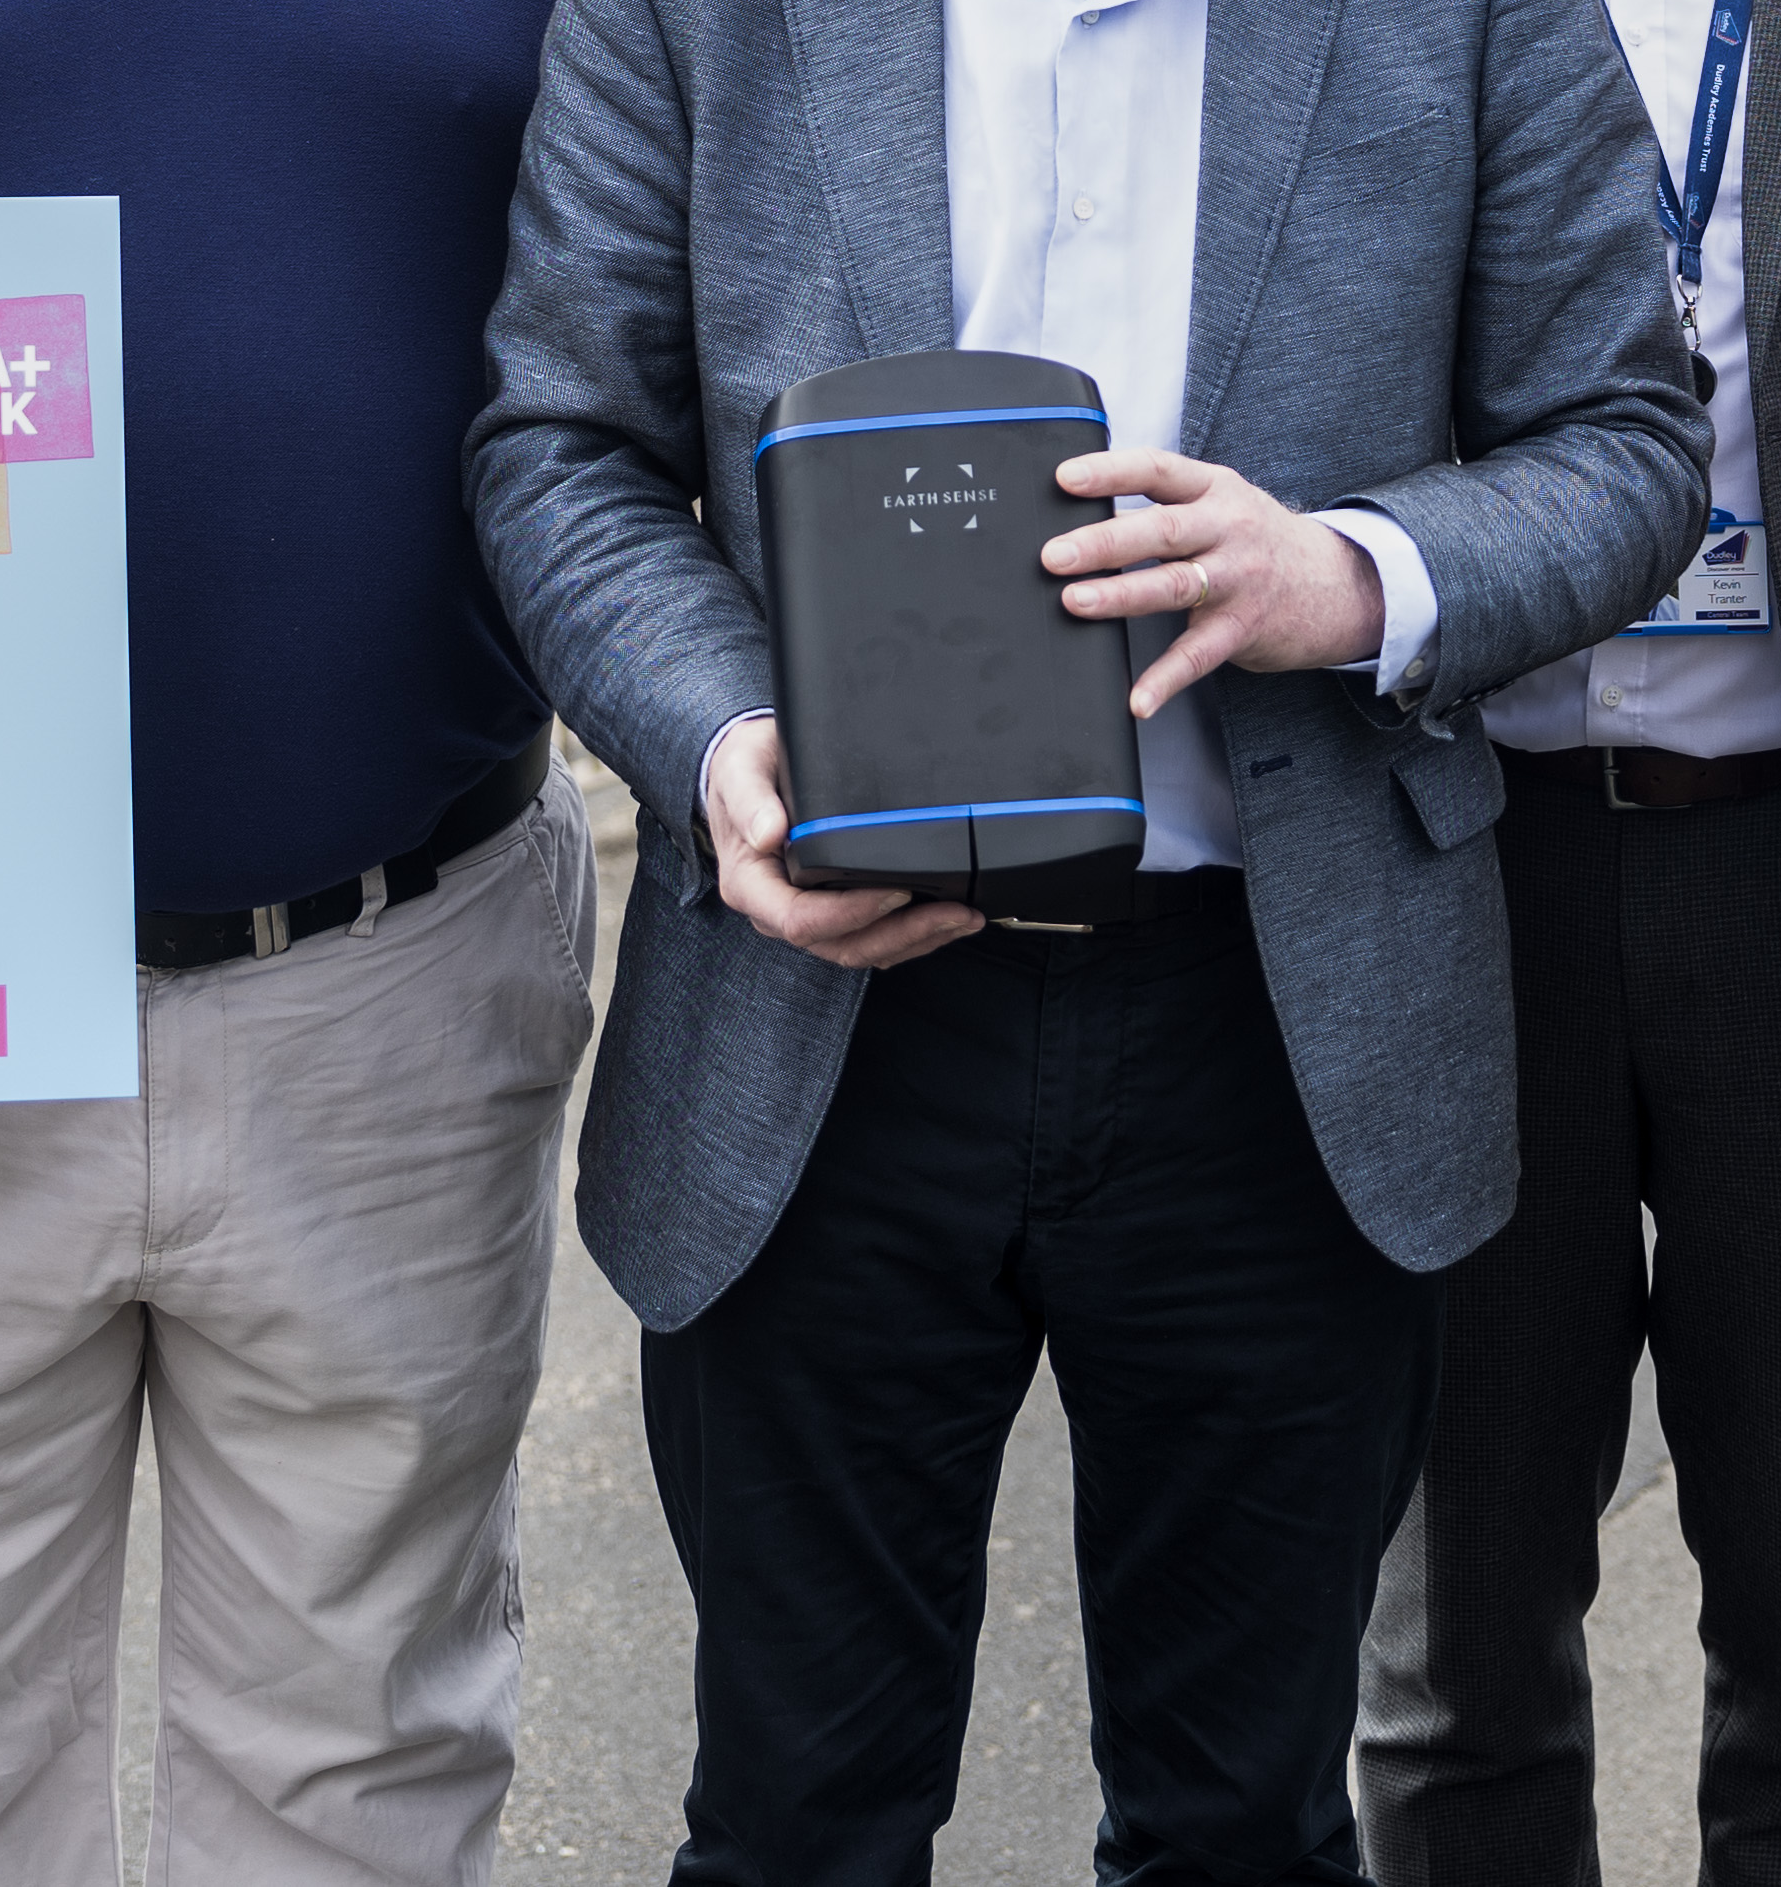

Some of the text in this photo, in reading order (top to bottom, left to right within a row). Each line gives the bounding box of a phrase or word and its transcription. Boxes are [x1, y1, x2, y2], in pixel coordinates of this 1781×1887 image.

[1699, 64, 1726, 173] Dudley Academies Trust
[1706, 552, 1737, 562] Dudley
[1713, 579, 1741, 589] Kevin
[1707, 593, 1747, 604] Tranter
